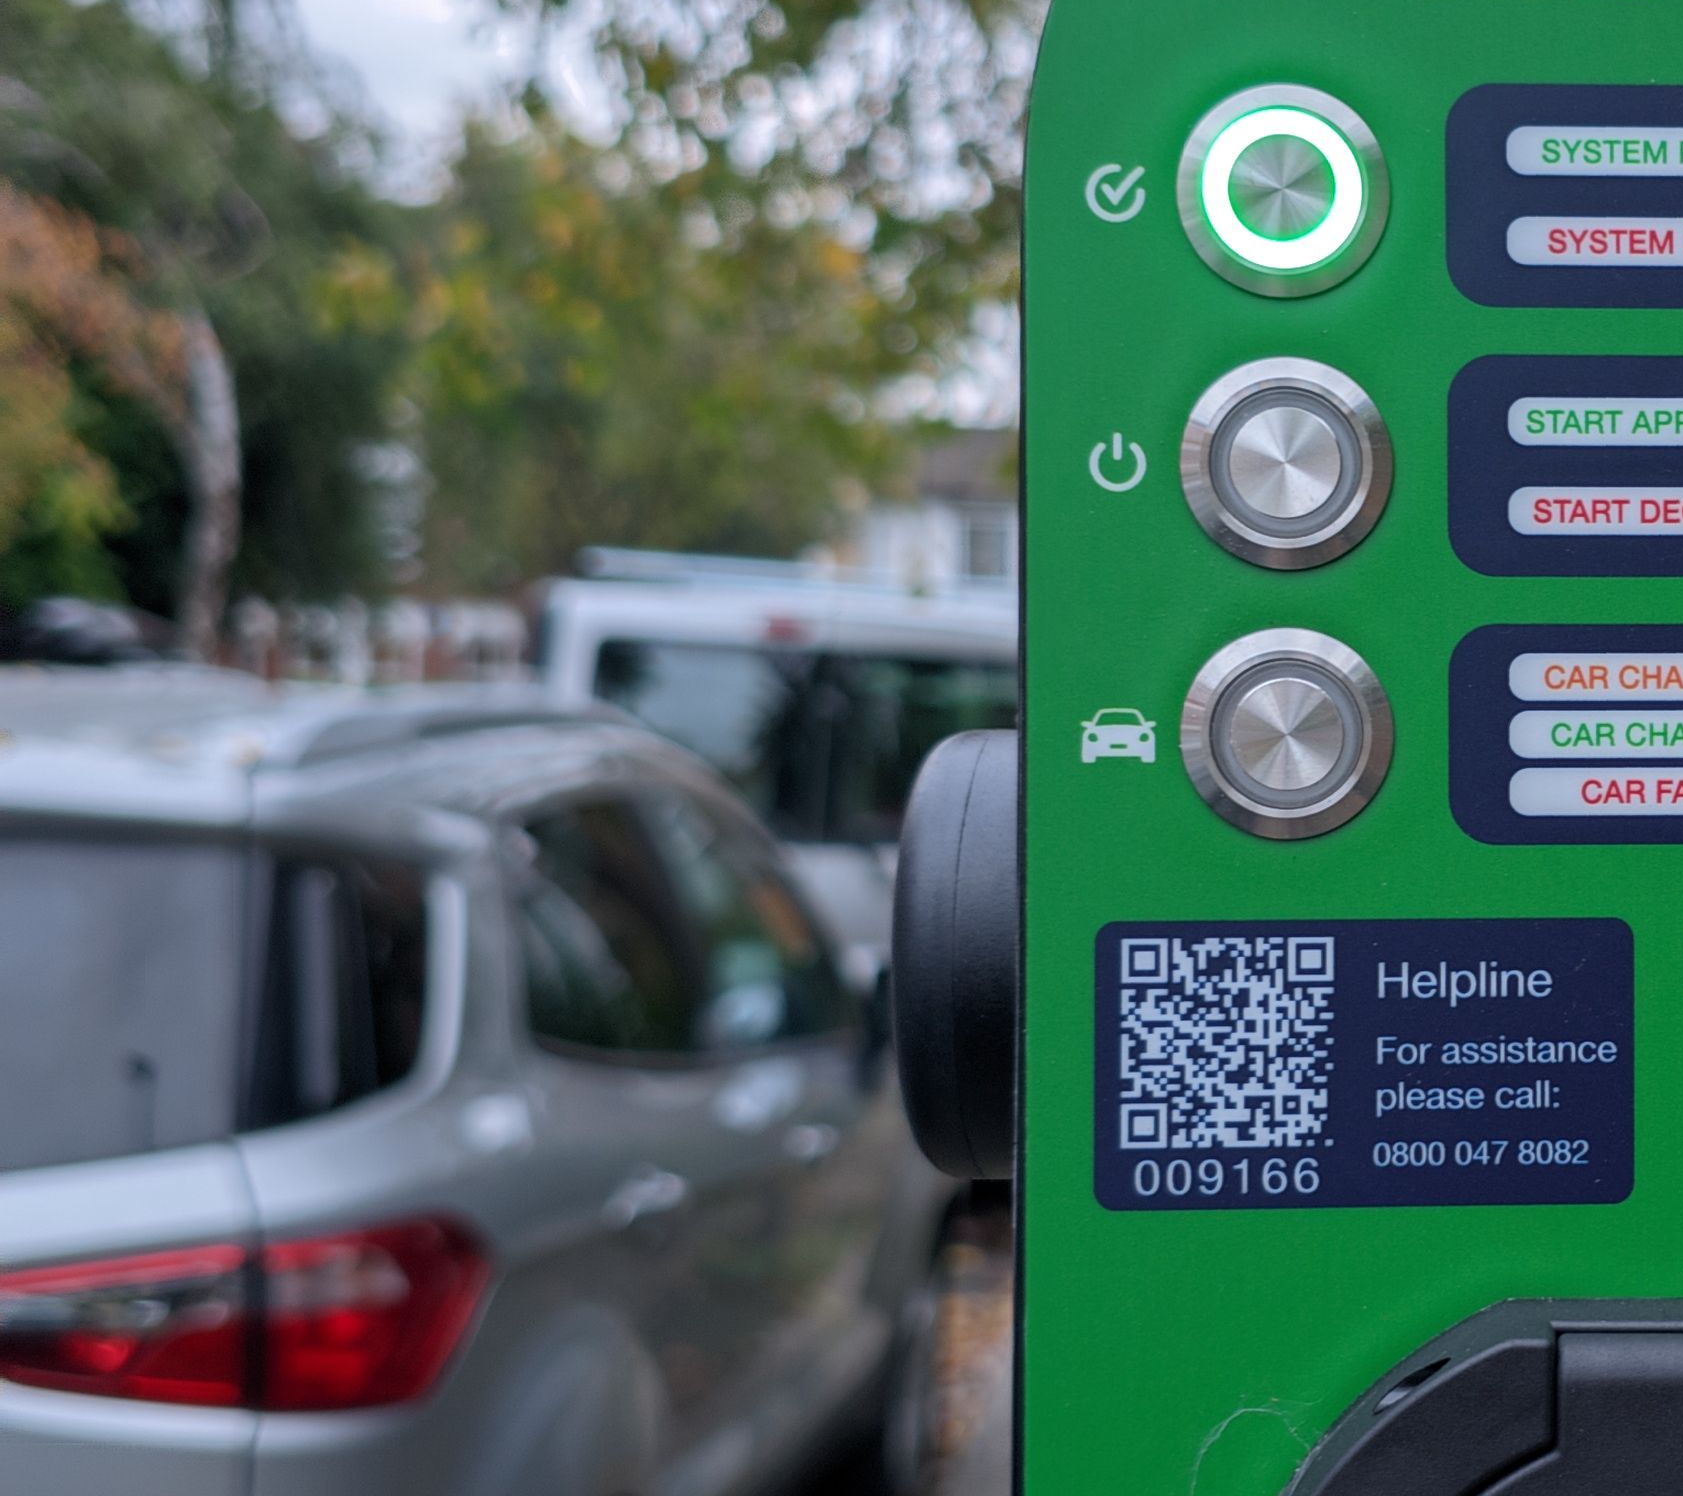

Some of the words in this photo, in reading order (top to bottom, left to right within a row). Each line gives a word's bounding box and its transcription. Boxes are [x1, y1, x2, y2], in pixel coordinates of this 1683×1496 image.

[1541, 138, 1668, 165] SYSTEM
[1547, 228, 1674, 255] SYSTEM
[1526, 409, 1623, 435] START
[1532, 498, 1630, 525] START
[1544, 664, 1609, 691] CAR
[1550, 721, 1615, 748] CAR
[1581, 778, 1646, 805] CAR
[1376, 960, 1553, 1008] Helpline
[1375, 1035, 1433, 1065] For
[1441, 1035, 1618, 1065] assistance
[1375, 1081, 1485, 1118] please
[1494, 1079, 1560, 1109] call:
[1372, 1141, 1446, 1168] 0800
[1454, 1140, 1509, 1167] 047
[1517, 1139, 1590, 1166] 8082
[1133, 1157, 1321, 1197] 009166
